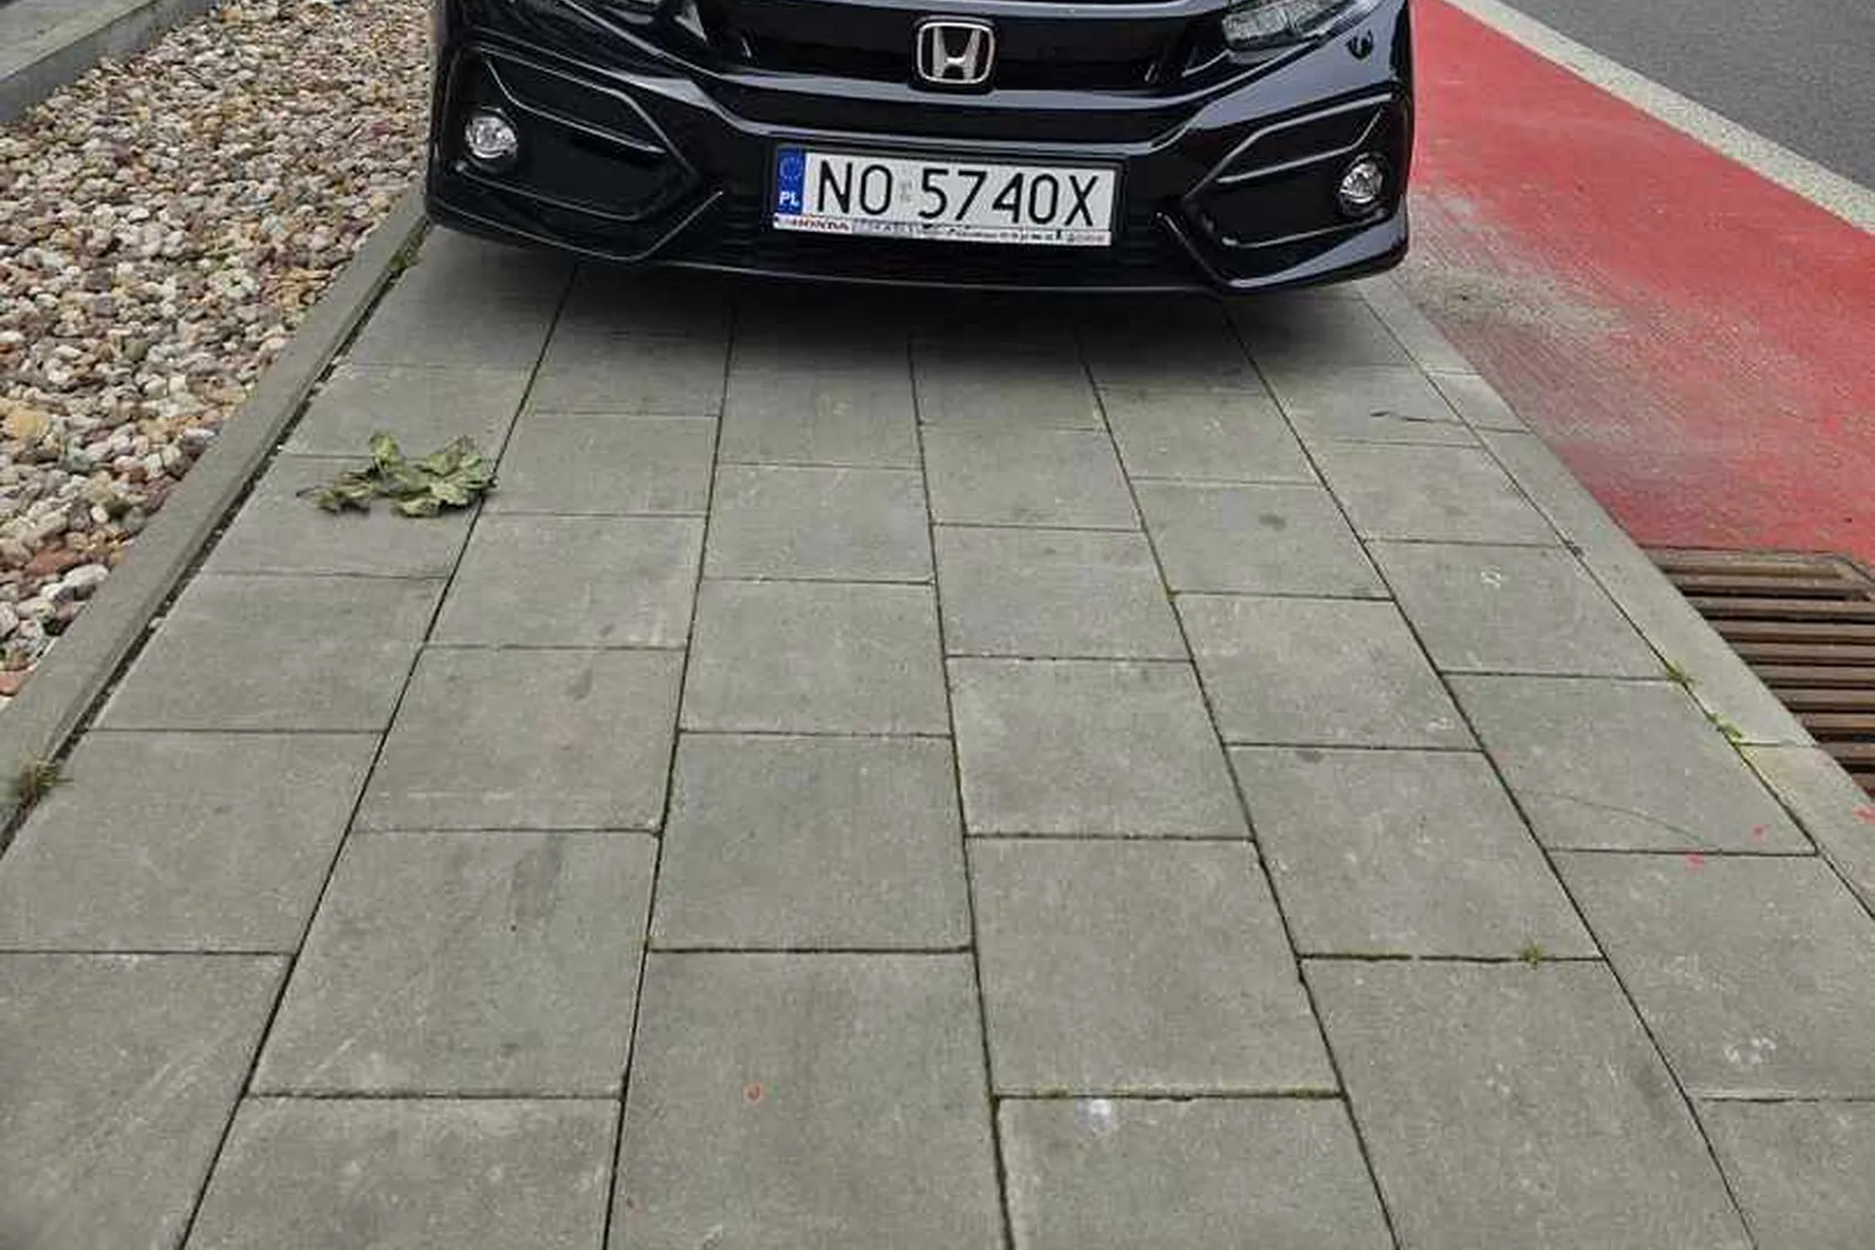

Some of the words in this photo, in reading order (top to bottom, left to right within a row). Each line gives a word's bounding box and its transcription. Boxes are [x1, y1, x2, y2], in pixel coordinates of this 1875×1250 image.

[779, 191, 799, 207] PL
[816, 159, 893, 216] NO
[918, 167, 1099, 227] 5740X
[791, 217, 849, 231] HONDA
